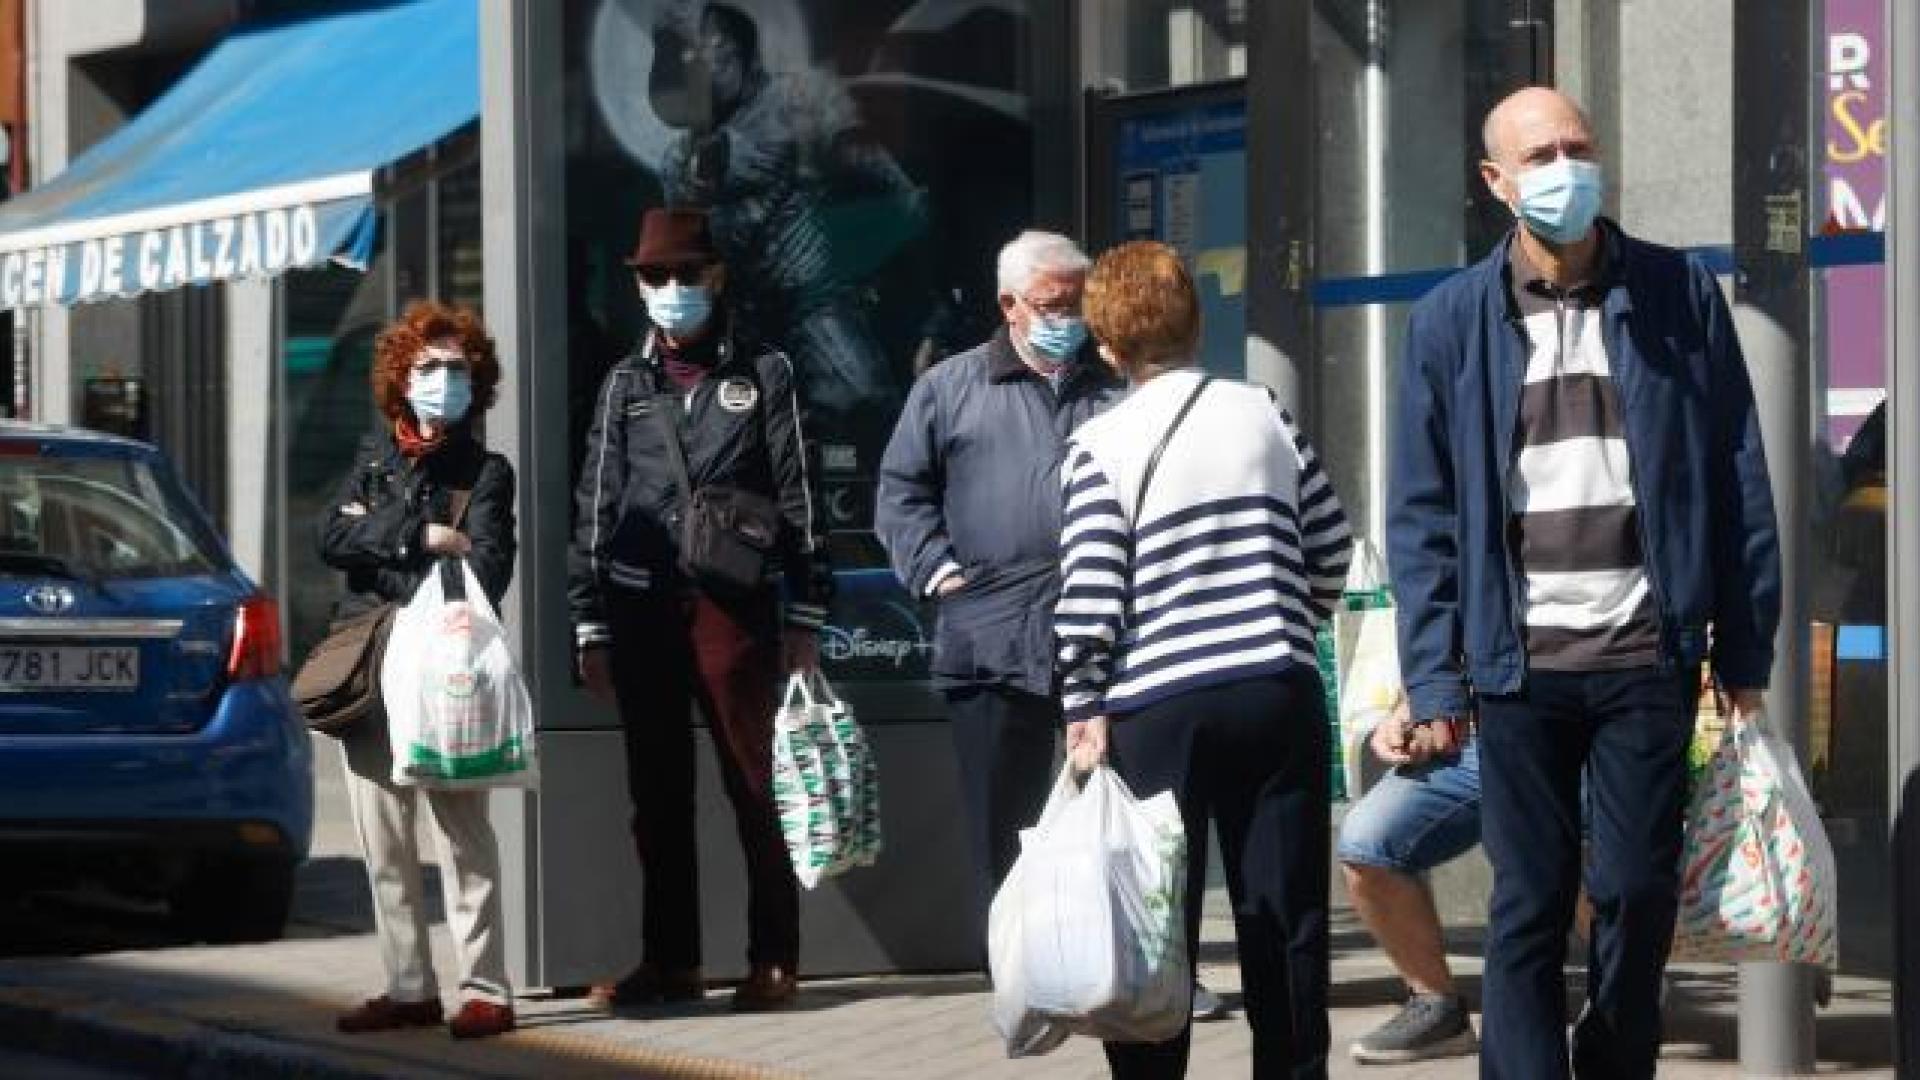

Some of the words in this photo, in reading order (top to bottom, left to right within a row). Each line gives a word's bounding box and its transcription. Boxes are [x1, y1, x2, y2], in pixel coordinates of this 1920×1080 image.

[80, 235, 125, 298] DE
[139, 206, 315, 292] CALZADO
[76, 650, 134, 681] JCK
